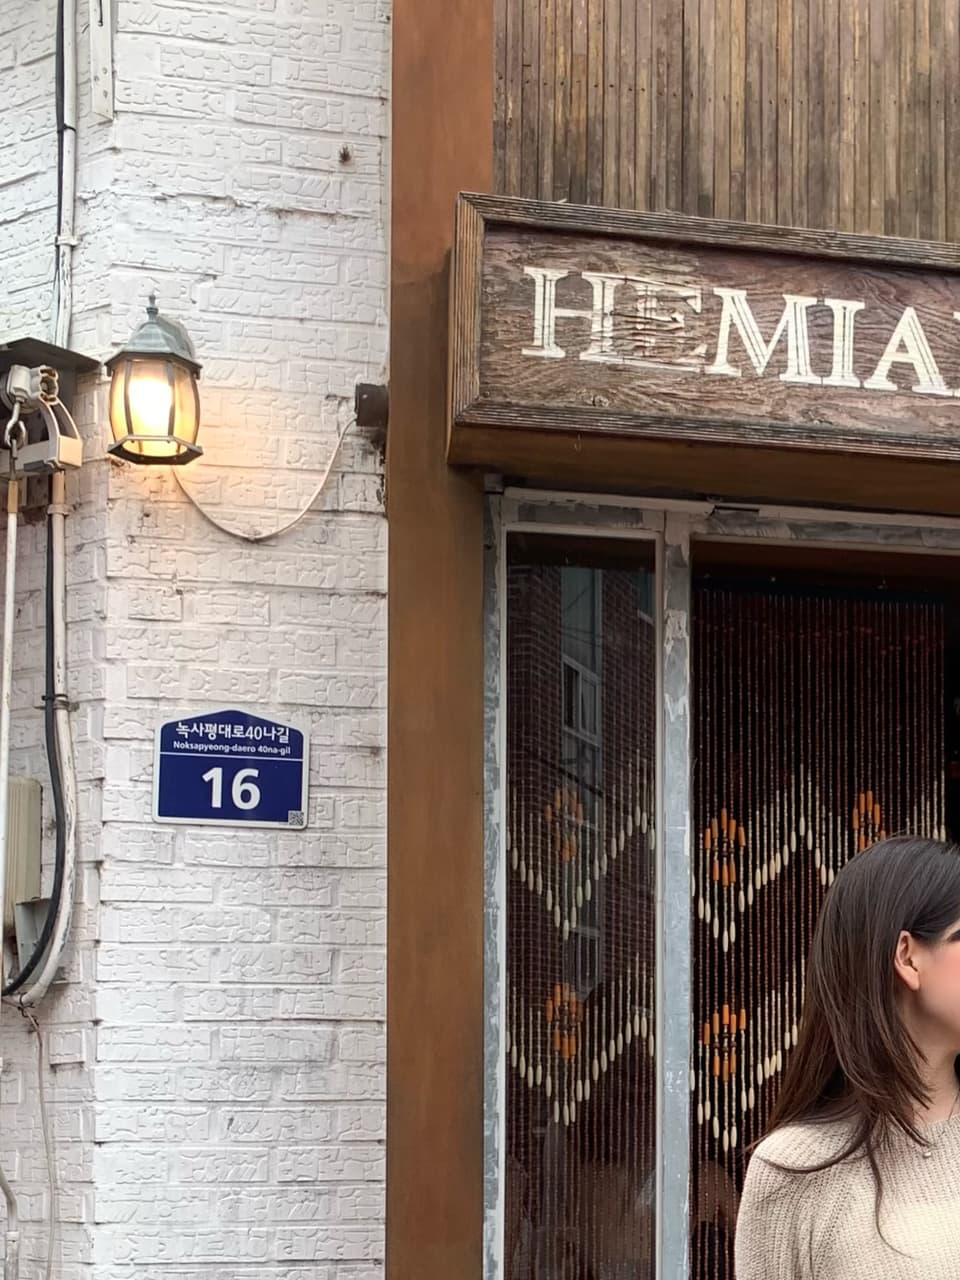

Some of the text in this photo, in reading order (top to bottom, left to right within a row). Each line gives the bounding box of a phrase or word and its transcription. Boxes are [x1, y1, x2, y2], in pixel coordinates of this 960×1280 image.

[176, 722, 290, 744] 녹사평대로40나길
[173, 741, 291, 756] Noksapyeong-daero 40na-gil
[202, 767, 261, 810] 16
